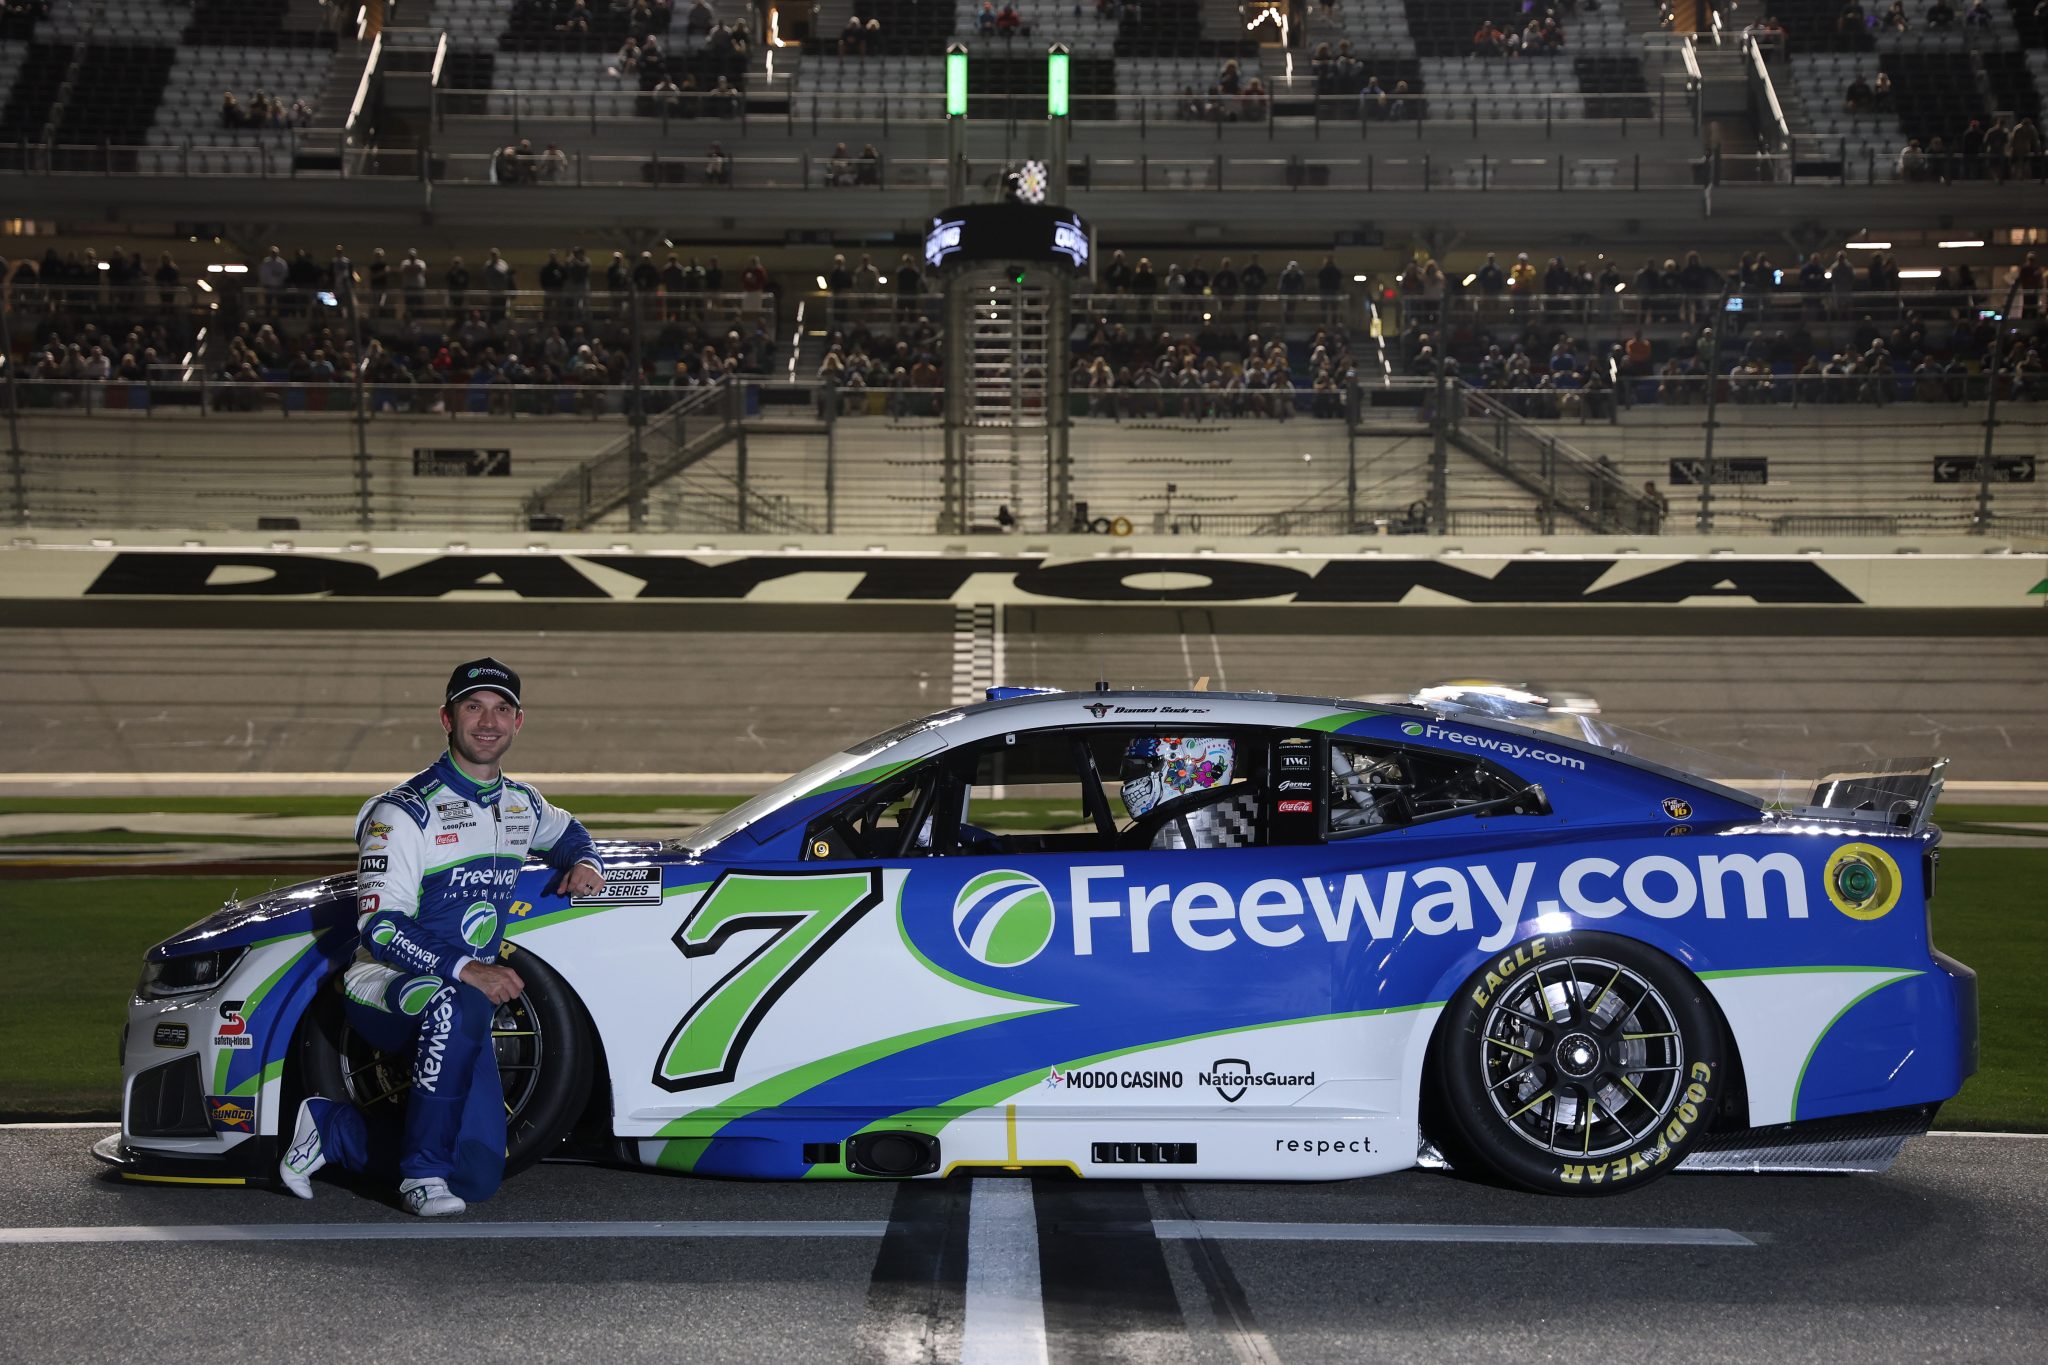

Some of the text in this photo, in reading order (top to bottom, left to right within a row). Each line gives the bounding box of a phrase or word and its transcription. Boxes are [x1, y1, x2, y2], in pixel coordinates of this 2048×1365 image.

[83, 551, 1865, 604] DAYTONA
[1425, 724, 1586, 771] Freeway.com
[1283, 757, 1308, 766] TWG
[1663, 799, 1678, 807] THE
[442, 822, 477, 830] GOODYEAR
[362, 858, 386, 870] TWG
[448, 867, 520, 890] Freeway
[608, 885, 649, 897] SERIES
[1069, 853, 1809, 957] Freeway.com
[391, 930, 440, 968] Freeway
[651, 866, 884, 1094] 7
[1472, 937, 1547, 1009] EAGLE
[1066, 1070, 1184, 1089] MODO CASINO
[1198, 1071, 1316, 1087] NationsGuard
[212, 1109, 253, 1120] SUNOCO
[1559, 1061, 1712, 1185] GOODYEAR
[1275, 1137, 1379, 1156] respect.
